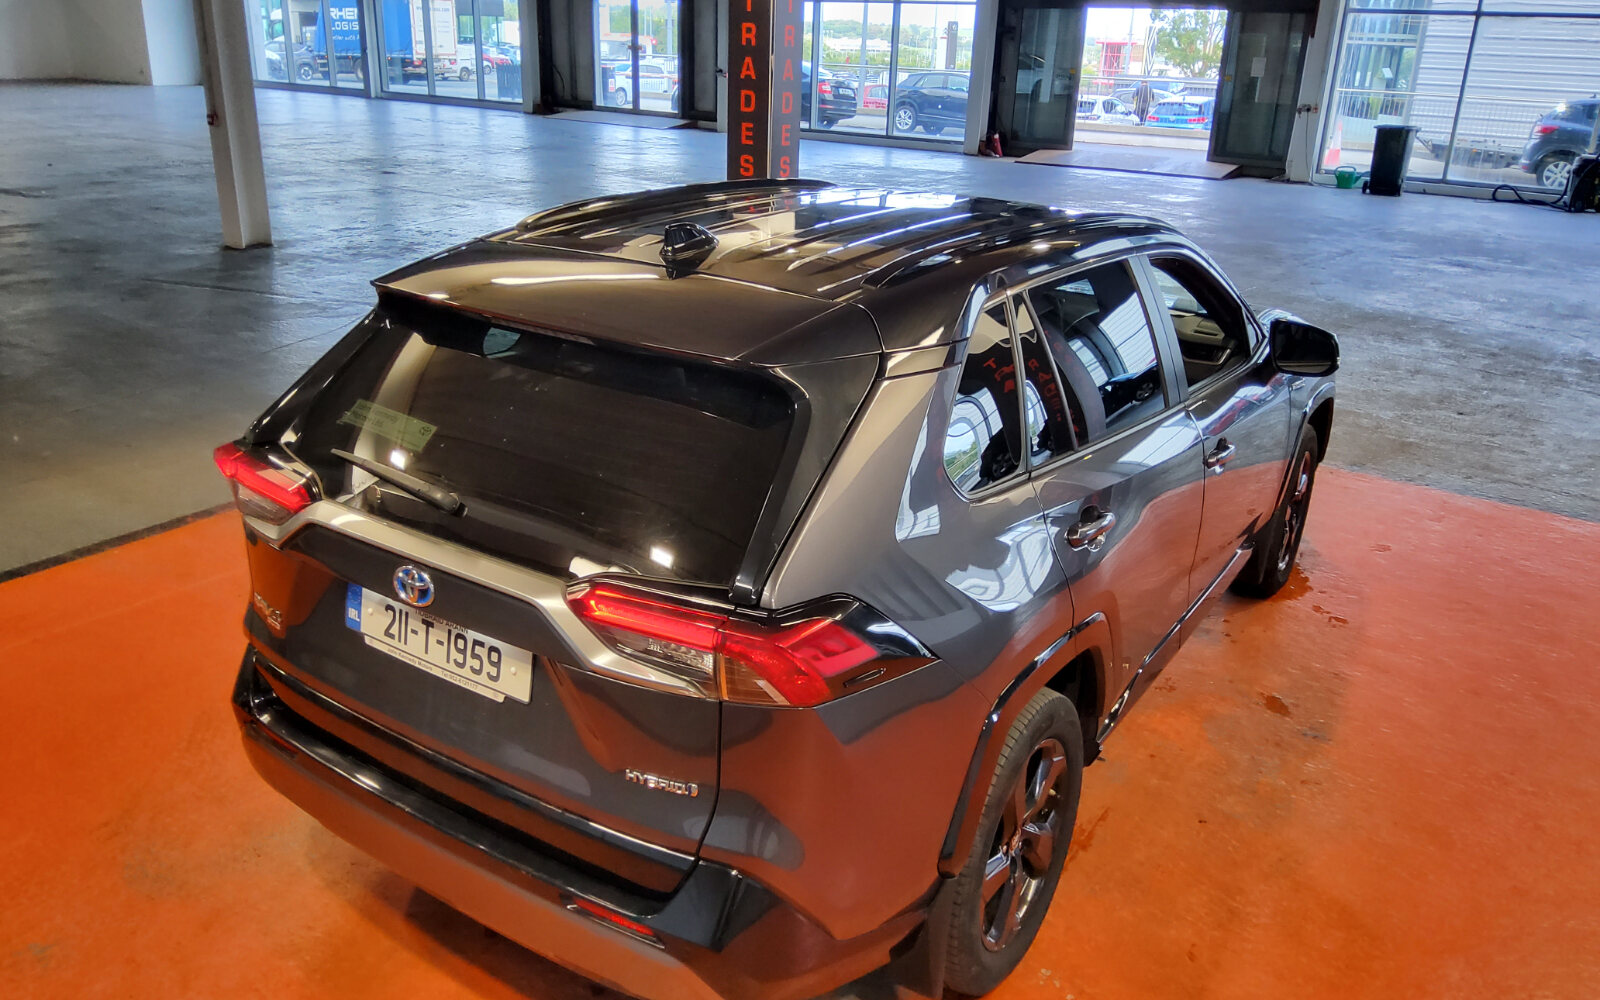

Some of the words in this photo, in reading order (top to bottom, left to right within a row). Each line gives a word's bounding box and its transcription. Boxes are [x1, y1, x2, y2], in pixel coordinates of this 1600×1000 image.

[348, 607, 360, 622] IRL
[383, 603, 503, 684] 211-T-1959
[625, 768, 687, 796] HYBRID
